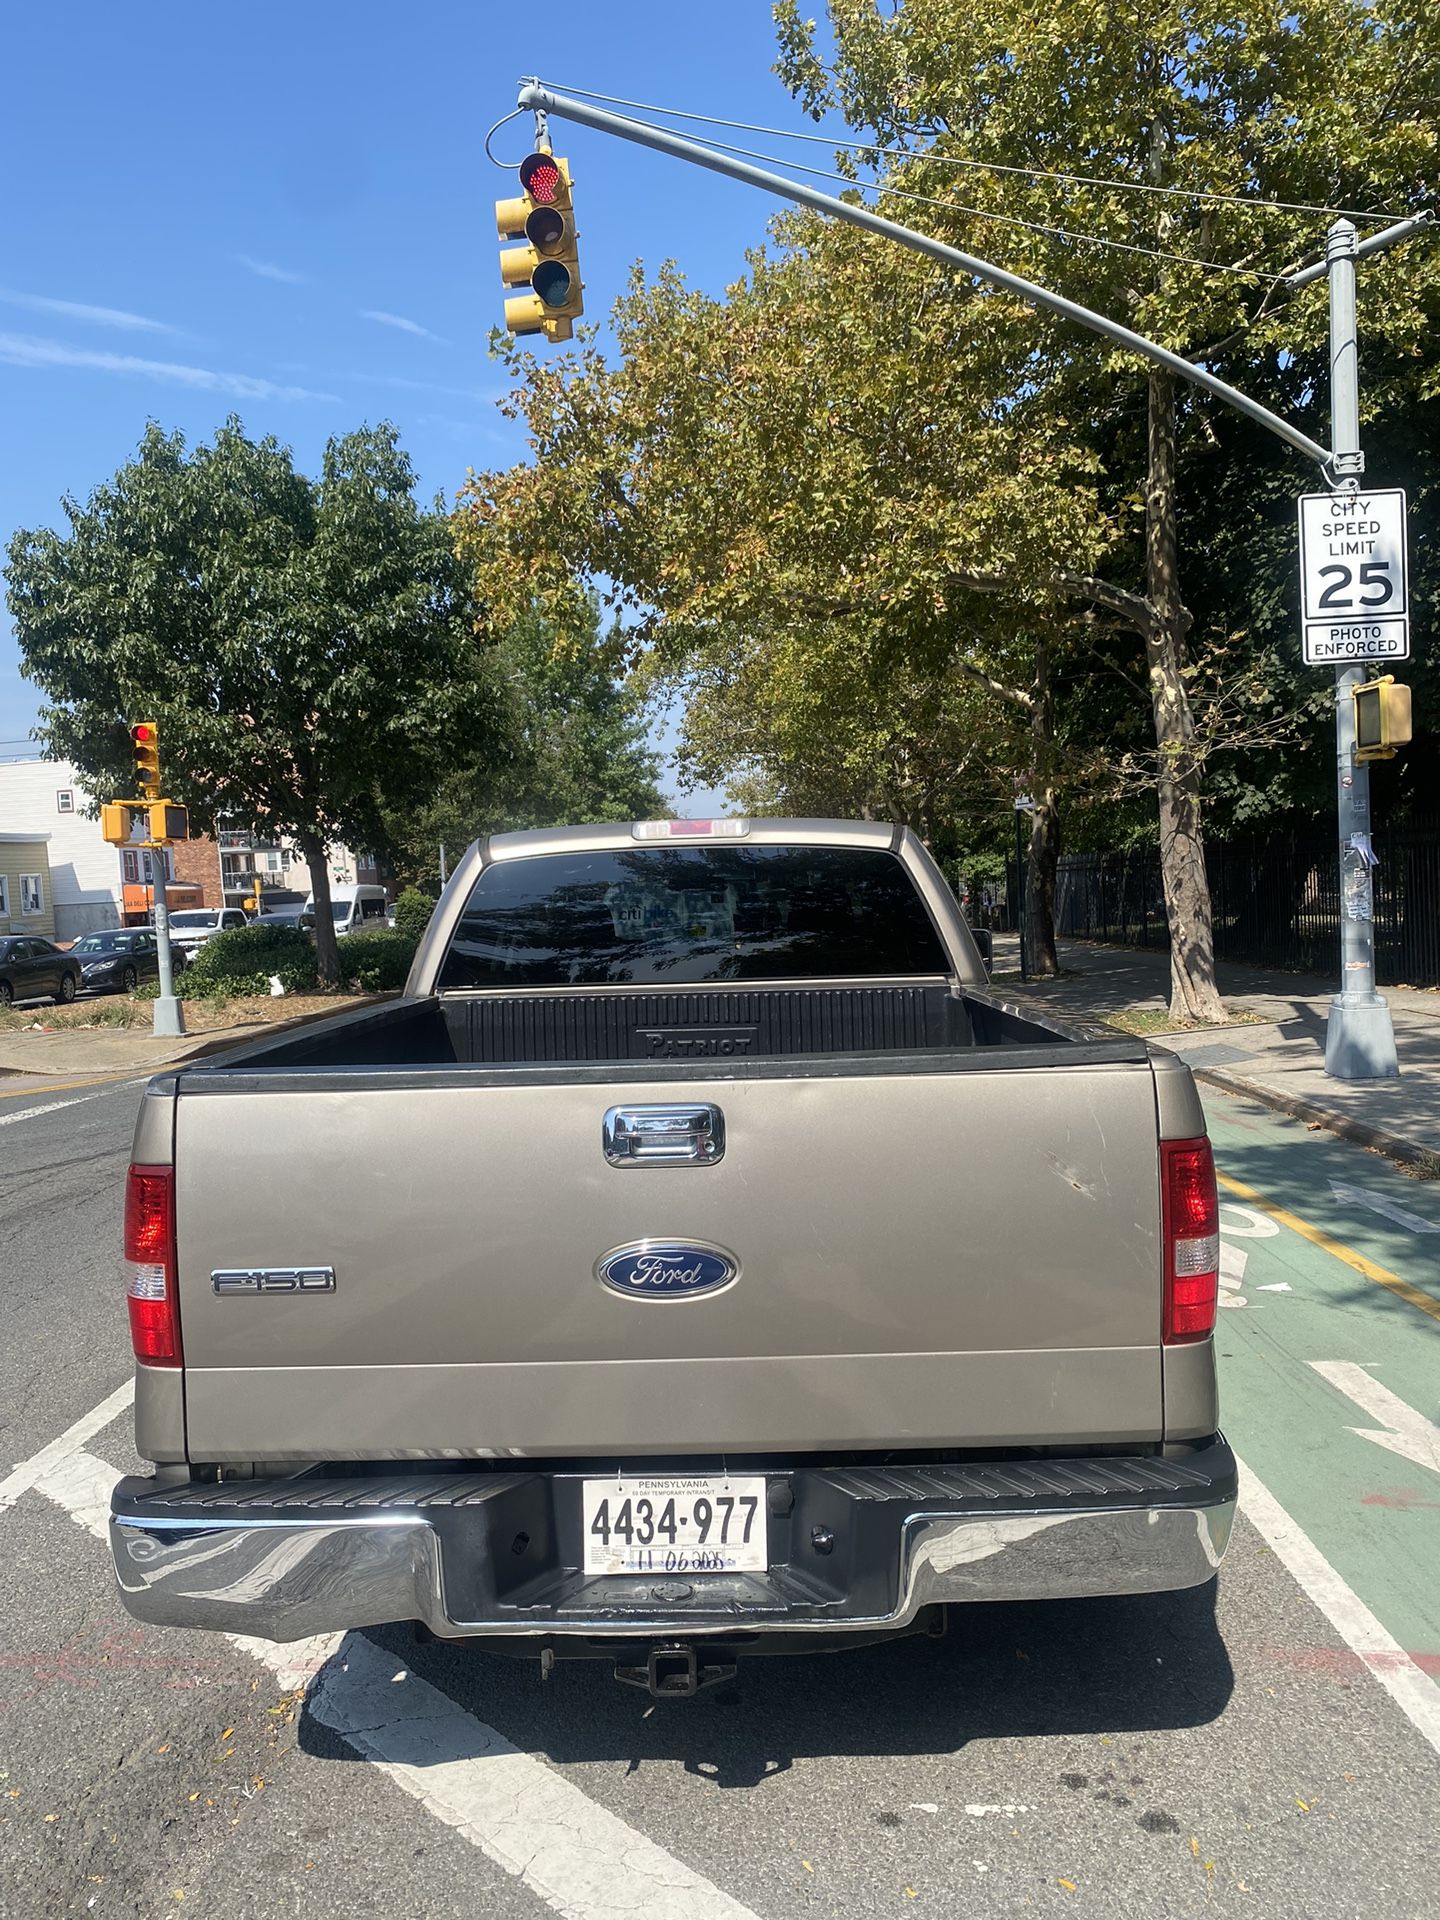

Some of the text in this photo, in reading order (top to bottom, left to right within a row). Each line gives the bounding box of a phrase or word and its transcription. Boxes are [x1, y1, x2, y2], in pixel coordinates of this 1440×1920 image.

[1330, 501, 1371, 517] CITY
[1322, 521, 1381, 537] SPEED
[1329, 540, 1376, 556] LIMIT
[1317, 561, 1394, 609] 25
[1330, 626, 1382, 641] PHOTO
[1315, 640, 1398, 656] ENFORCED
[646, 1033, 751, 1057] PATRIOT
[629, 1255, 703, 1285] Ford
[638, 1480, 709, 1489] PENNSYLVANIA
[638, 1550, 652, 1570] 11
[665, 1551, 688, 1571] 06
